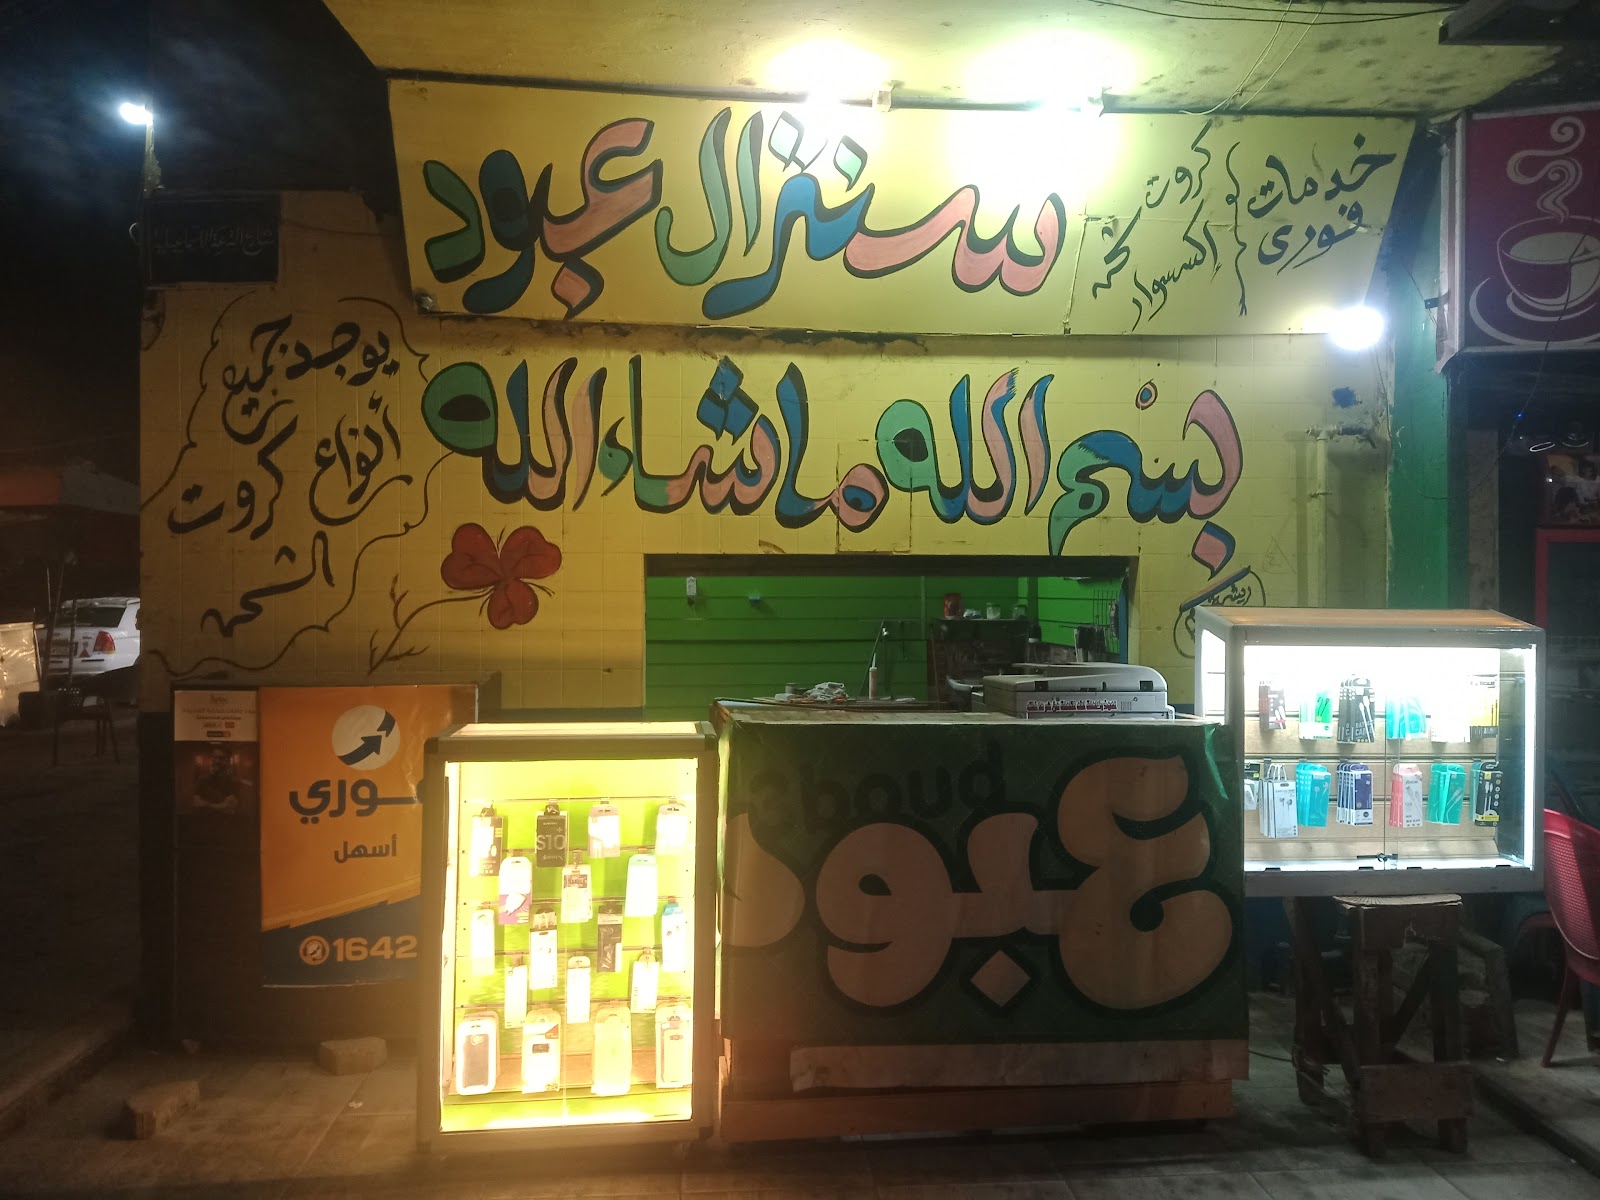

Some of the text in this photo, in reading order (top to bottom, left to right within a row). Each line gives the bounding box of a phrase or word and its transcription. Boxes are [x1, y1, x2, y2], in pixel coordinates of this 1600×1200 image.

[423, 107, 1065, 319] سنترال عبود
[1145, 118, 1213, 209] كروت
[1248, 132, 1396, 218] خدمات
[286, 322, 400, 386] يوجد
[168, 414, 298, 540] كروت
[421, 357, 607, 512] الله
[876, 367, 1054, 525] الله
[1048, 379, 1243, 580] بسم
[289, 779, 423, 824] وري
[333, 834, 397, 864] أسهل
[722, 755, 1233, 1010] عبود
